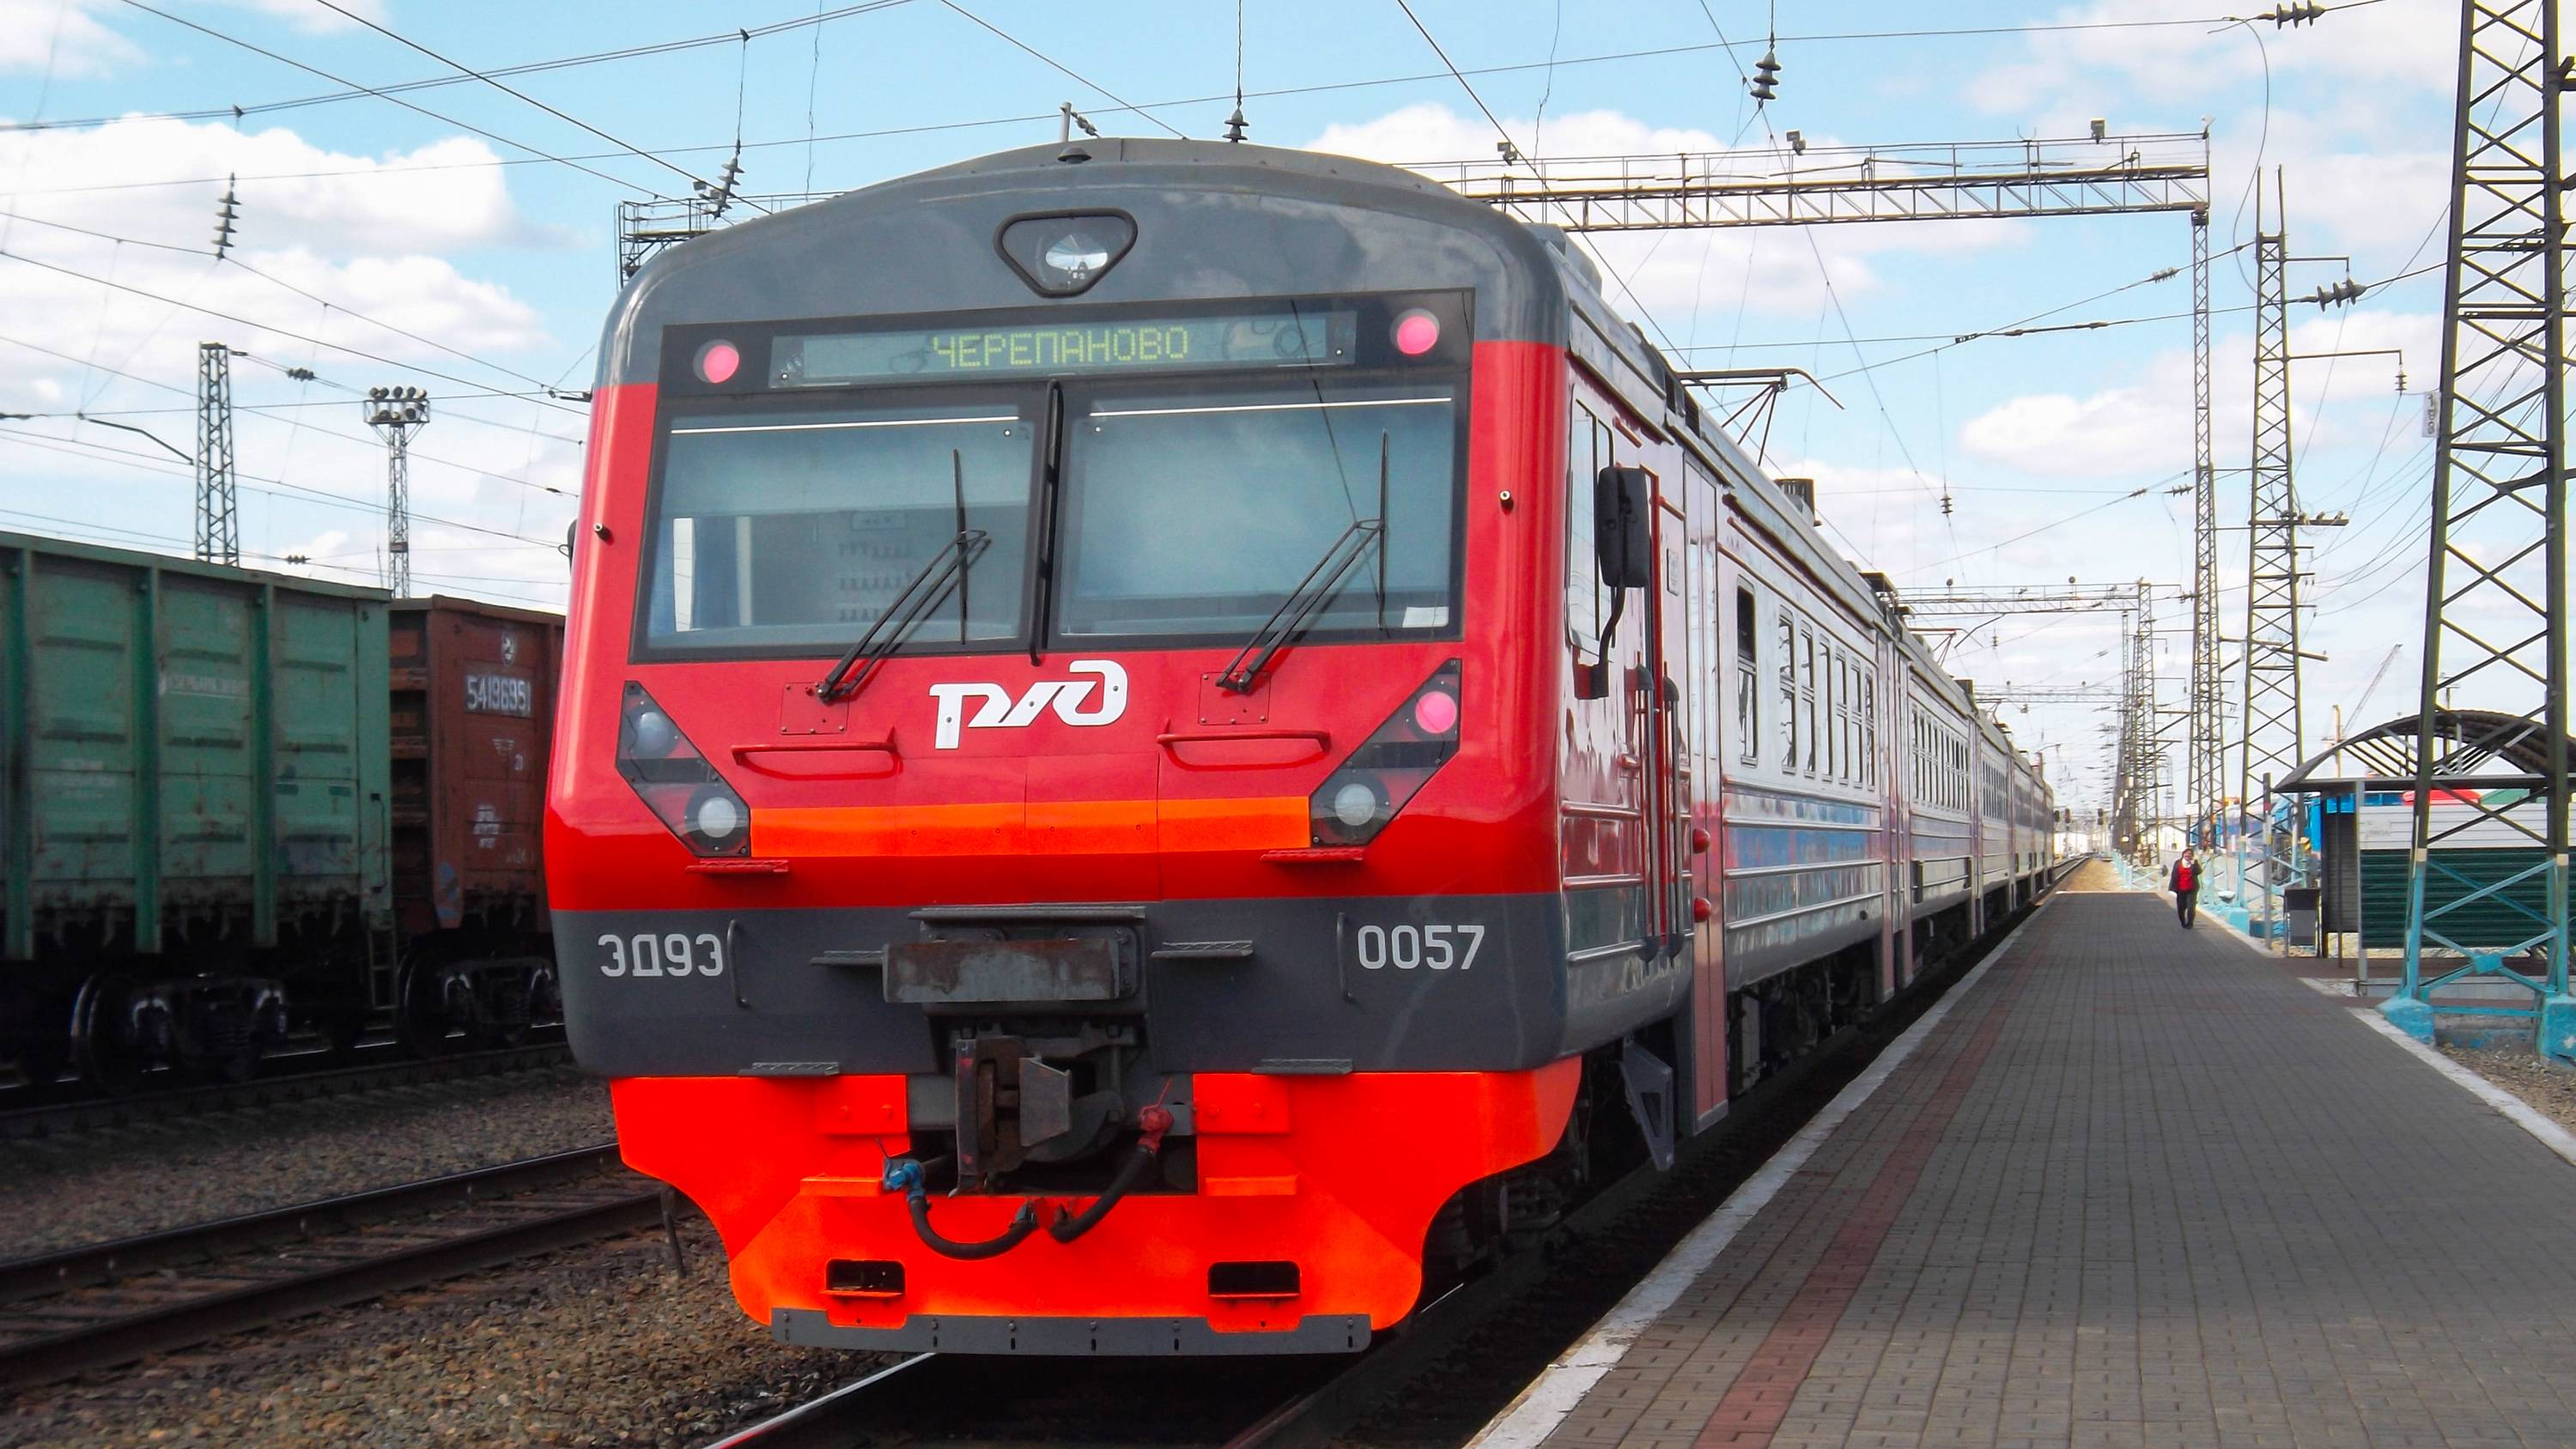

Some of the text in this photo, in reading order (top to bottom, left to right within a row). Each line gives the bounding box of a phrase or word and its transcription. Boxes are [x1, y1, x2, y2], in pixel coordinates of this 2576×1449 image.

[933, 326, 1188, 367] ЧЕРЕПАНОВО
[466, 674, 532, 716] 54196951
[929, 660, 1128, 749] РЖД
[1358, 925, 1485, 970] 0057
